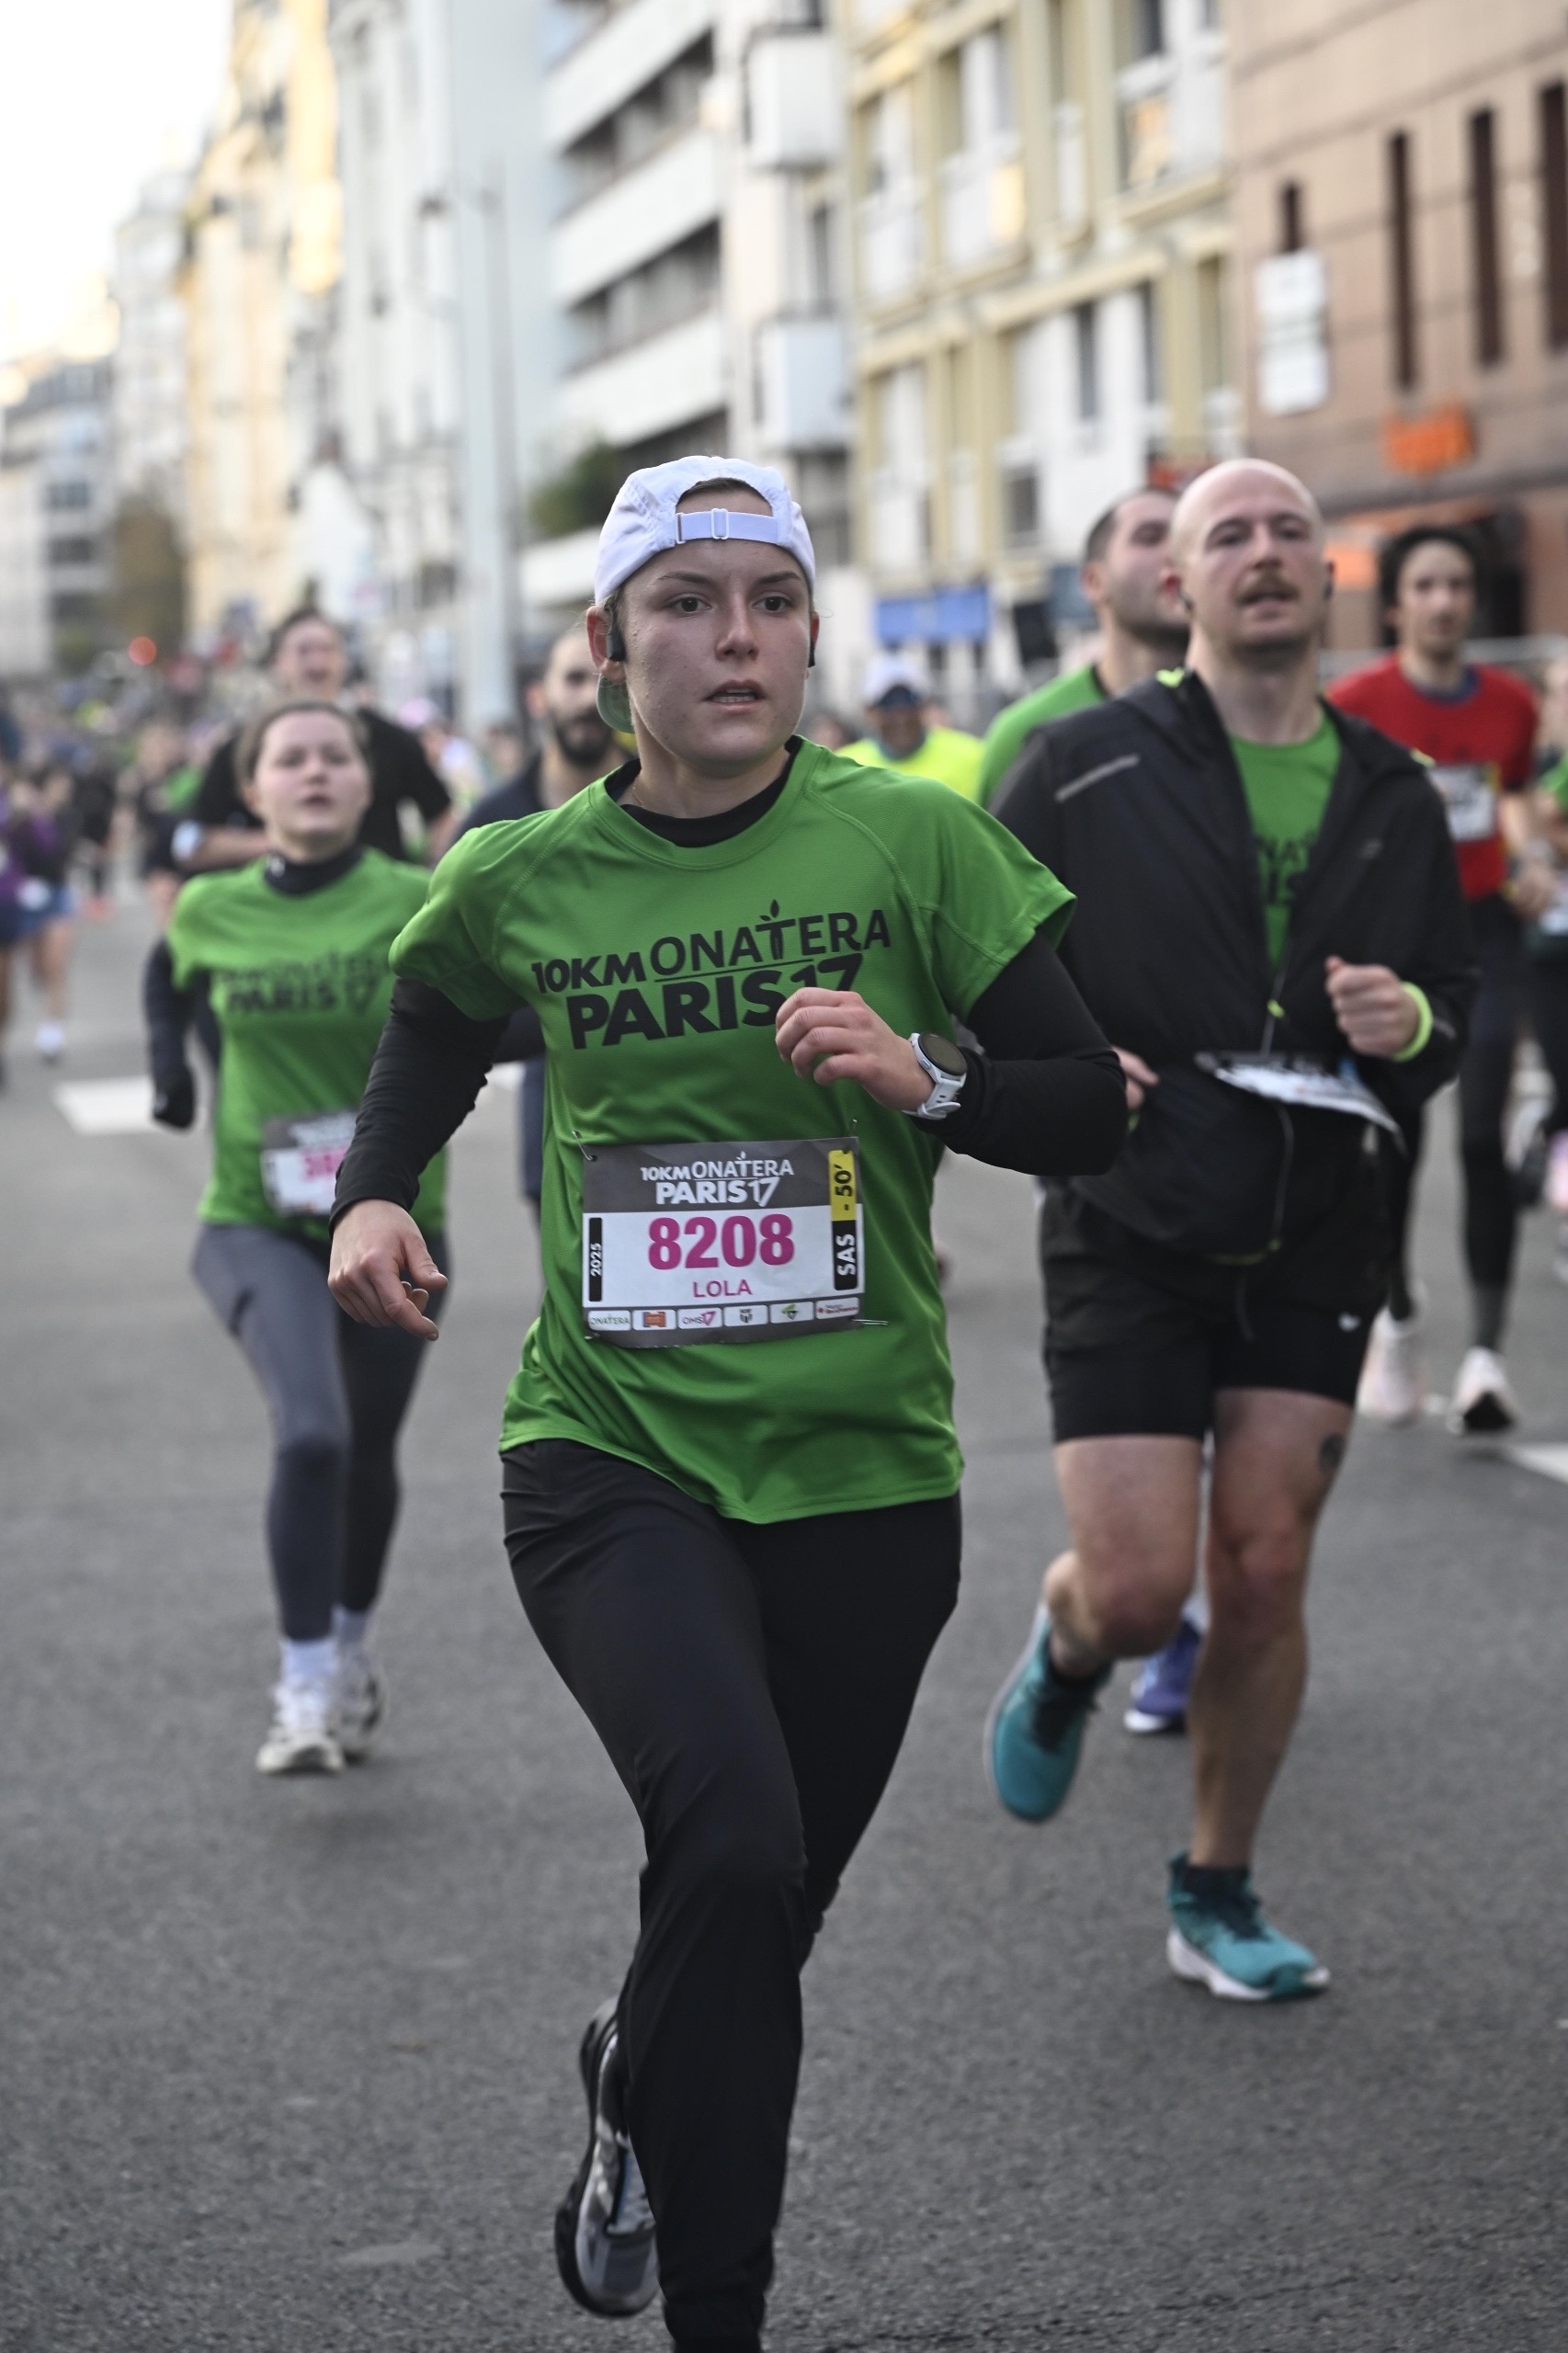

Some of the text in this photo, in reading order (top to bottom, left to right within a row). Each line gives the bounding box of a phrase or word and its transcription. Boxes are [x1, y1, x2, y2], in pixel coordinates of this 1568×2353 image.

[590, 1243, 602, 1277] 2025
[648, 1214, 794, 1270] 8208
[835, 1233, 856, 1276] SAS
[694, 1279, 753, 1298] LOLA
